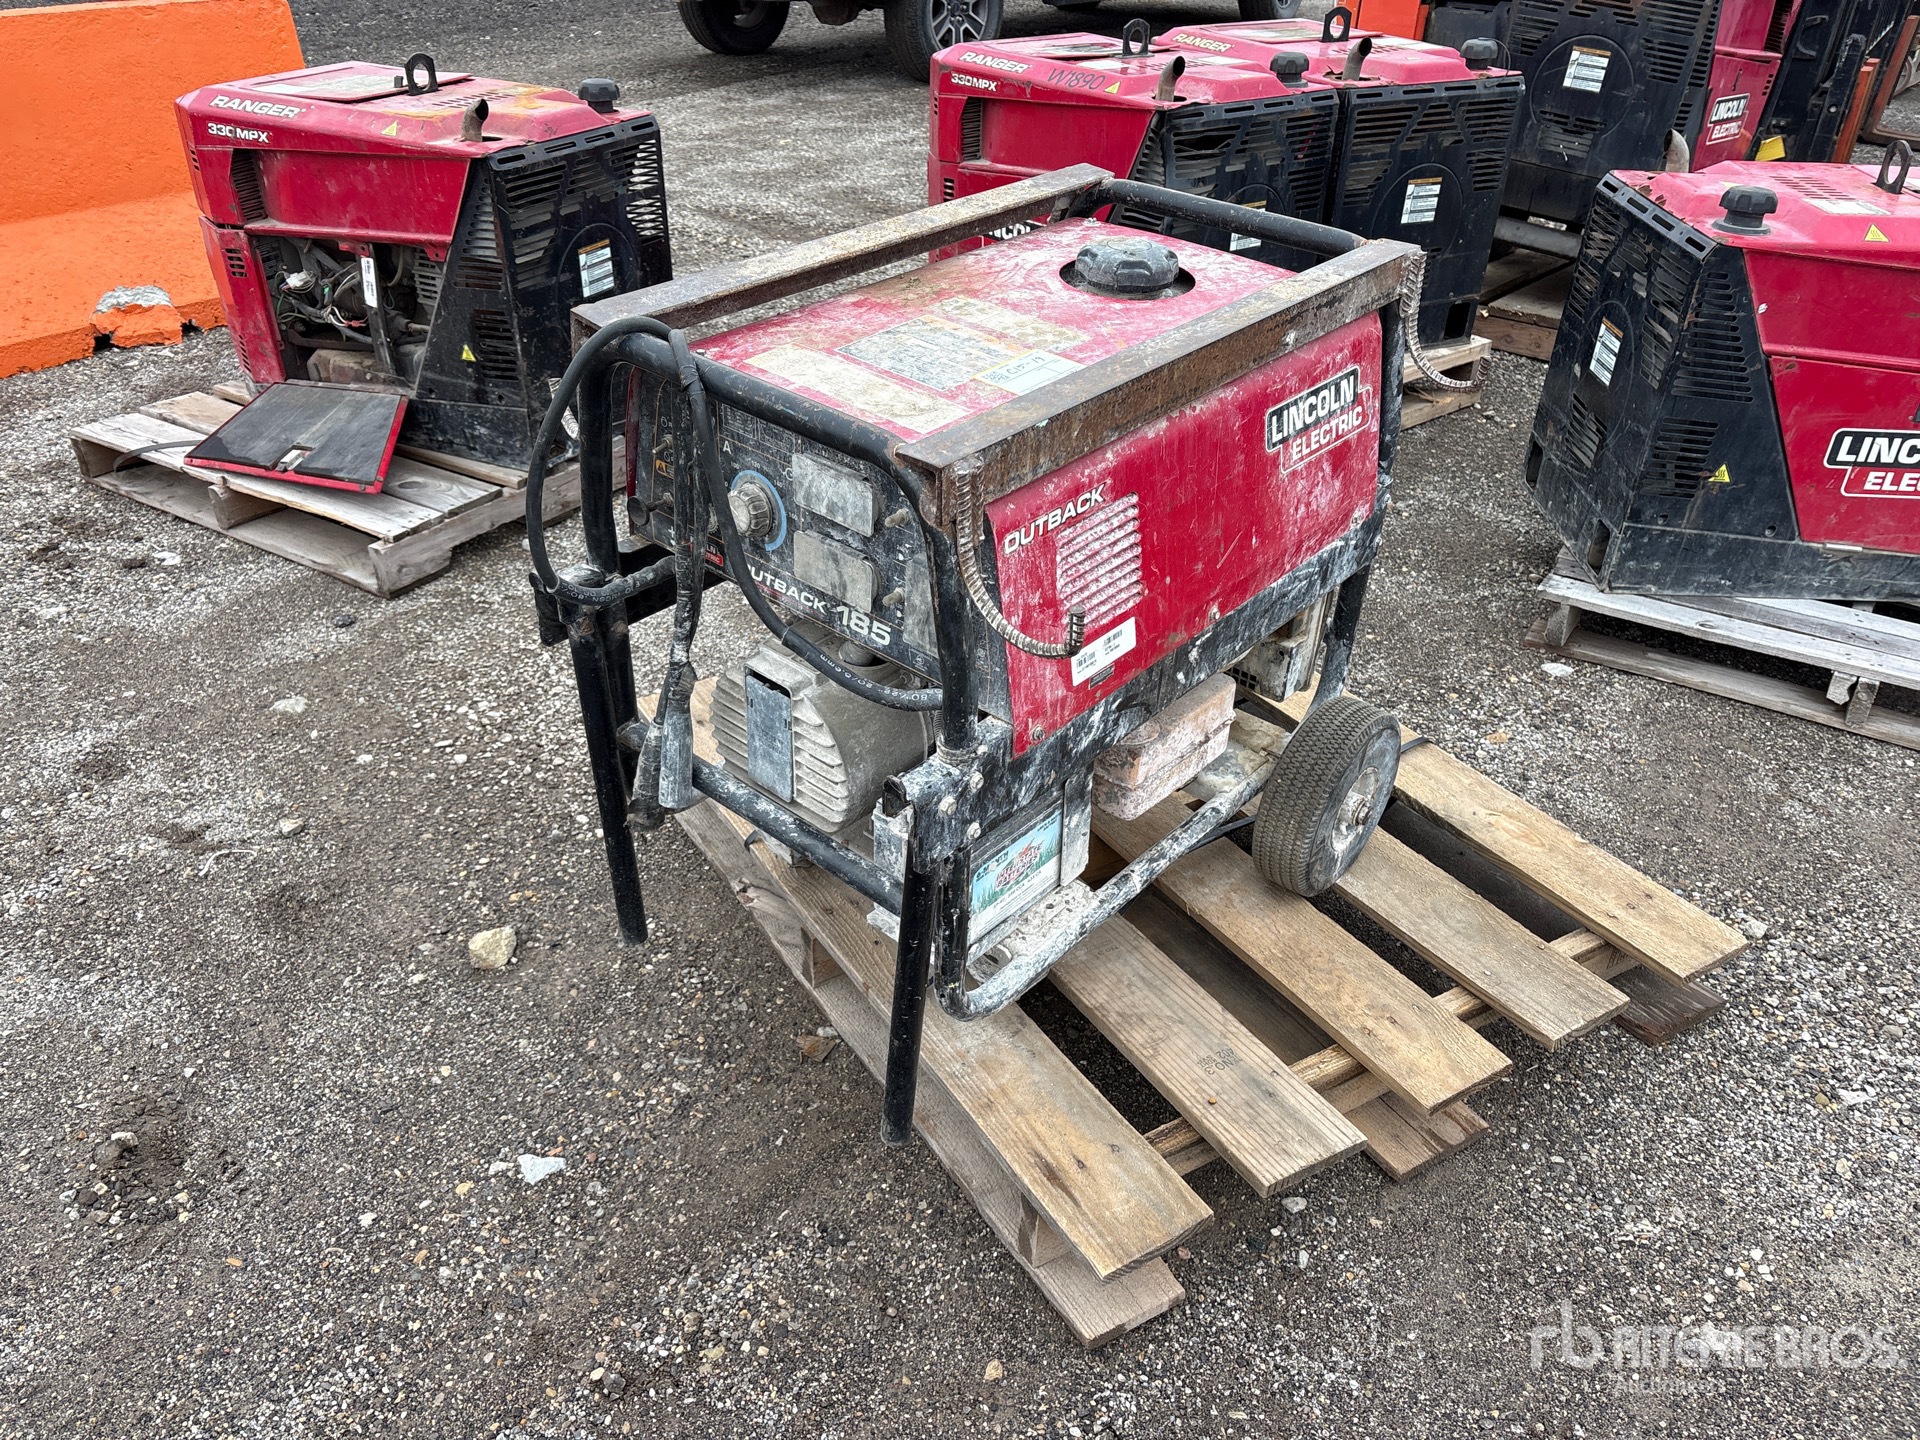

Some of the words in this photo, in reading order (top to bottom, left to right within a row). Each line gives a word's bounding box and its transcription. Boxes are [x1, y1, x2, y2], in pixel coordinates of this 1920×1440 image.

[1172, 33, 1231, 52] RANGER
[959, 51, 1029, 74] RANGER
[1047, 68, 1106, 90] W1890
[209, 95, 301, 119] RANGER
[1710, 98, 1747, 122] LINCOLN
[1711, 121, 1743, 140] ELECTRIC
[1271, 374, 1355, 444] LINCOLN
[1291, 405, 1363, 462] ELECTRIC
[722, 440, 732, 455] A
[1836, 435, 1920, 465] LINC
[1863, 471, 1920, 492] ELE
[1003, 483, 1106, 555] OUTBACK
[747, 563, 828, 616] UTBACK
[836, 606, 892, 646] 185
